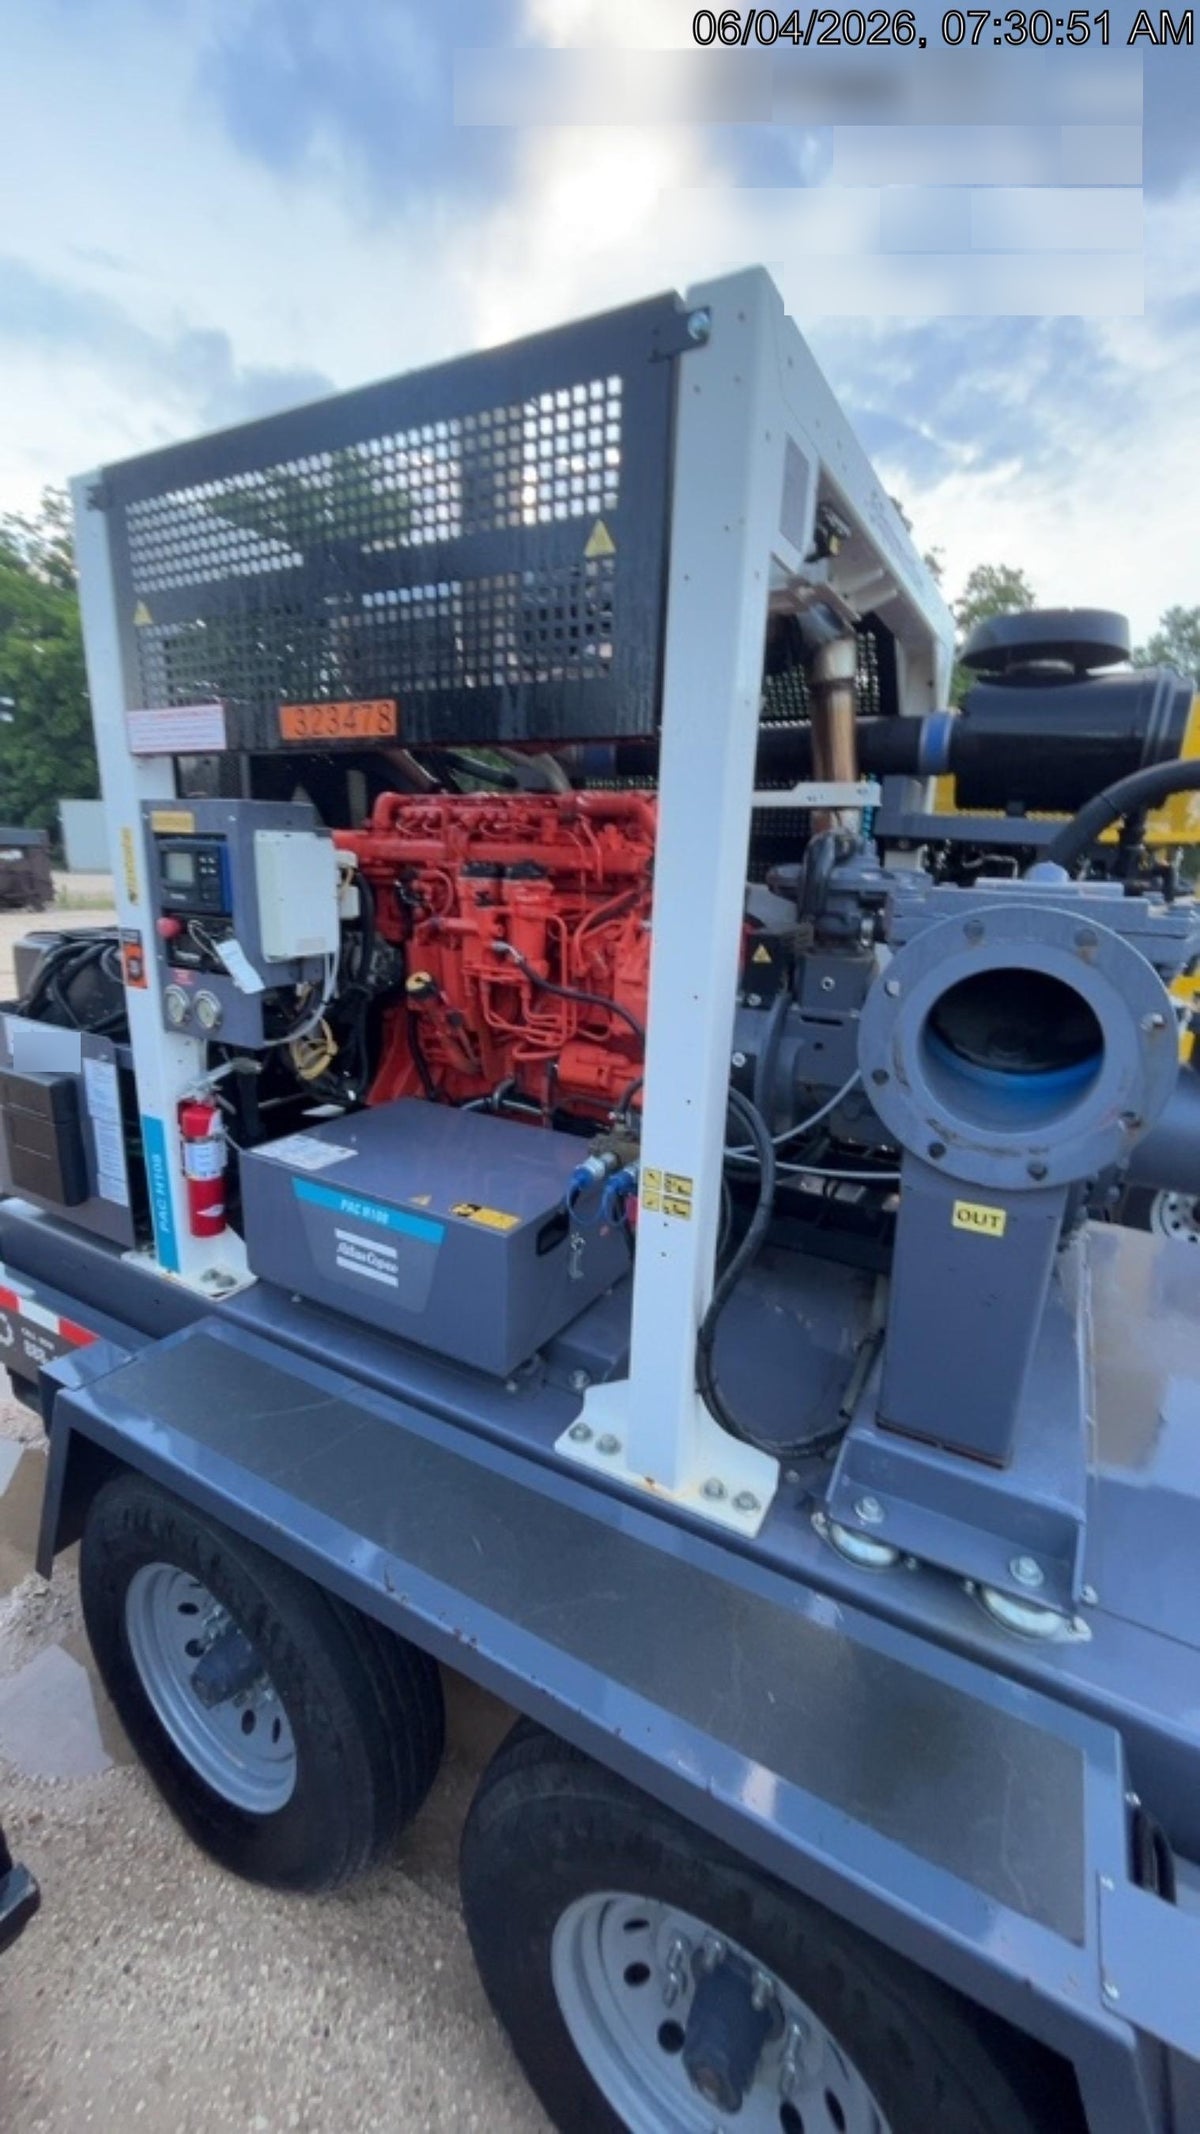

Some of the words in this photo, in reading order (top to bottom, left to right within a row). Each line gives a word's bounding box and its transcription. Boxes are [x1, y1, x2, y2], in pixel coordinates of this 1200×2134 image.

[294, 702, 392, 736] 323478
[155, 1197, 169, 1233] PAC
[340, 1198, 361, 1215] PAC
[957, 1208, 1001, 1228] OUT
